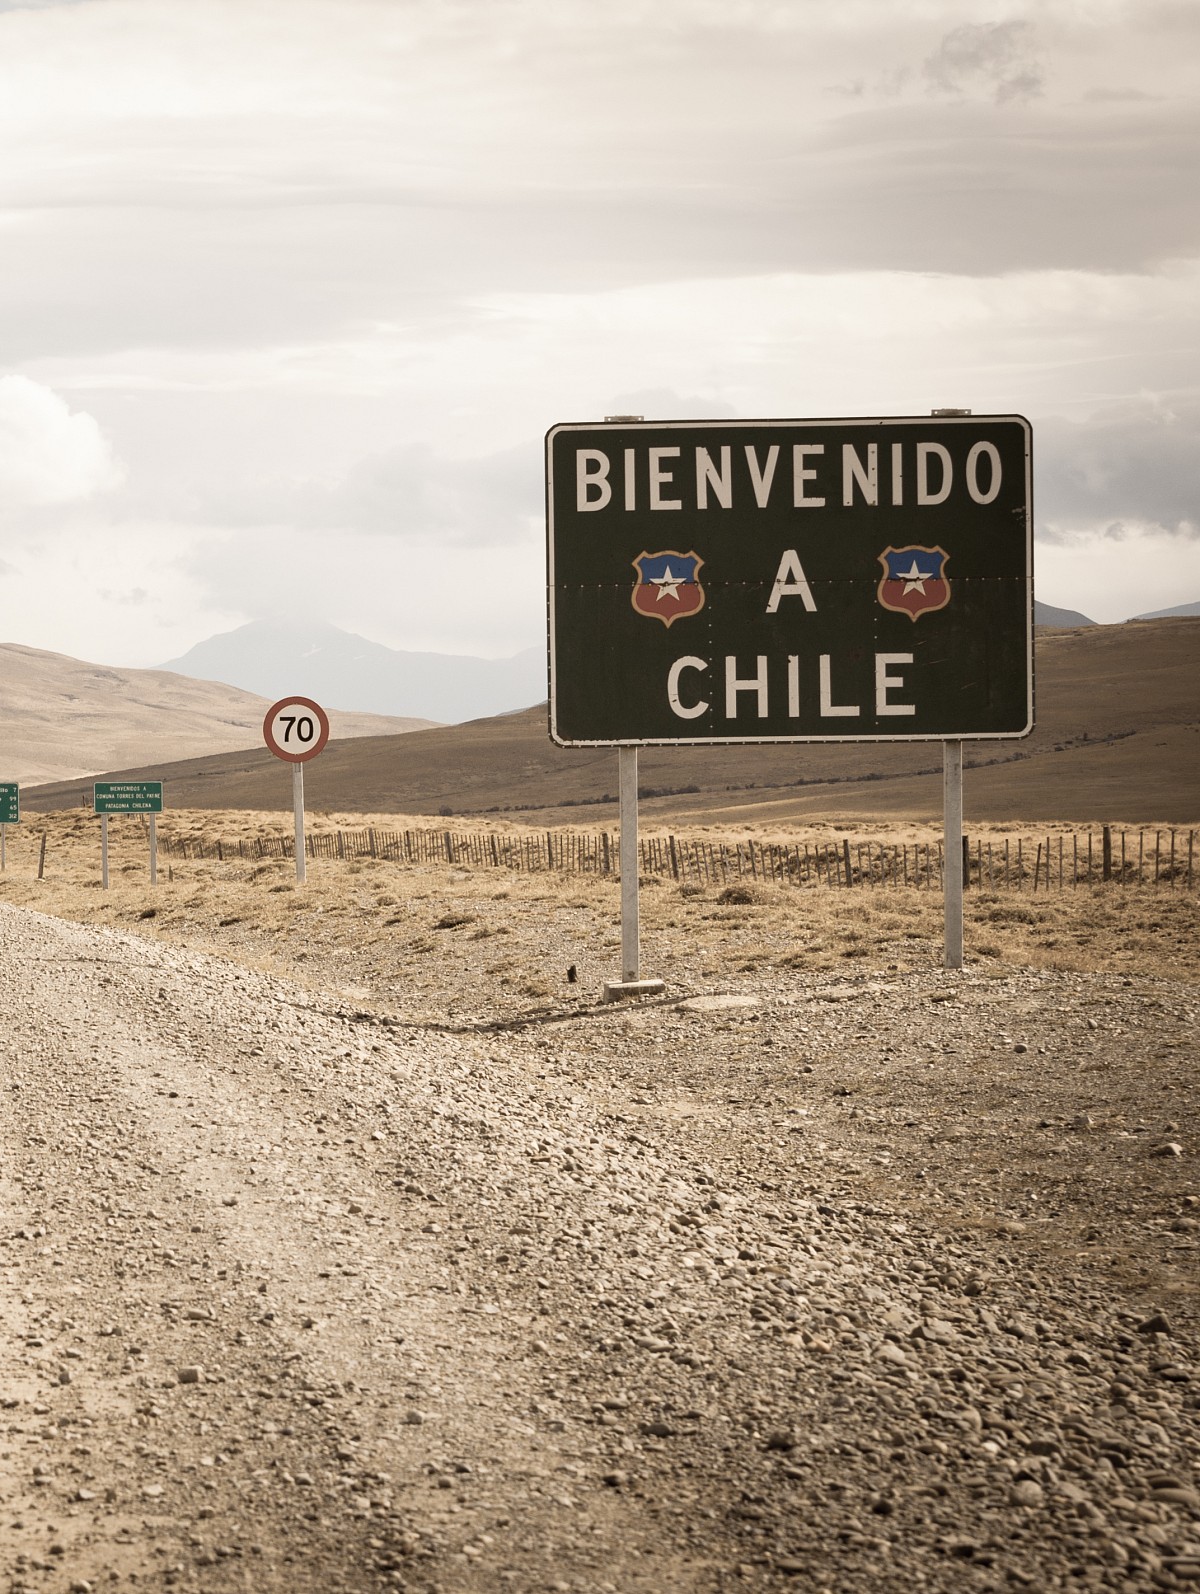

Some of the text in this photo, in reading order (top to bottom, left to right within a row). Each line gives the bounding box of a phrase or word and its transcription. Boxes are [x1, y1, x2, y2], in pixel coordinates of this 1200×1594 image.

[576, 440, 1002, 512] BIENVENIDO
[765, 549, 818, 613] A
[667, 652, 916, 719] CHILE
[280, 716, 314, 742] 70
